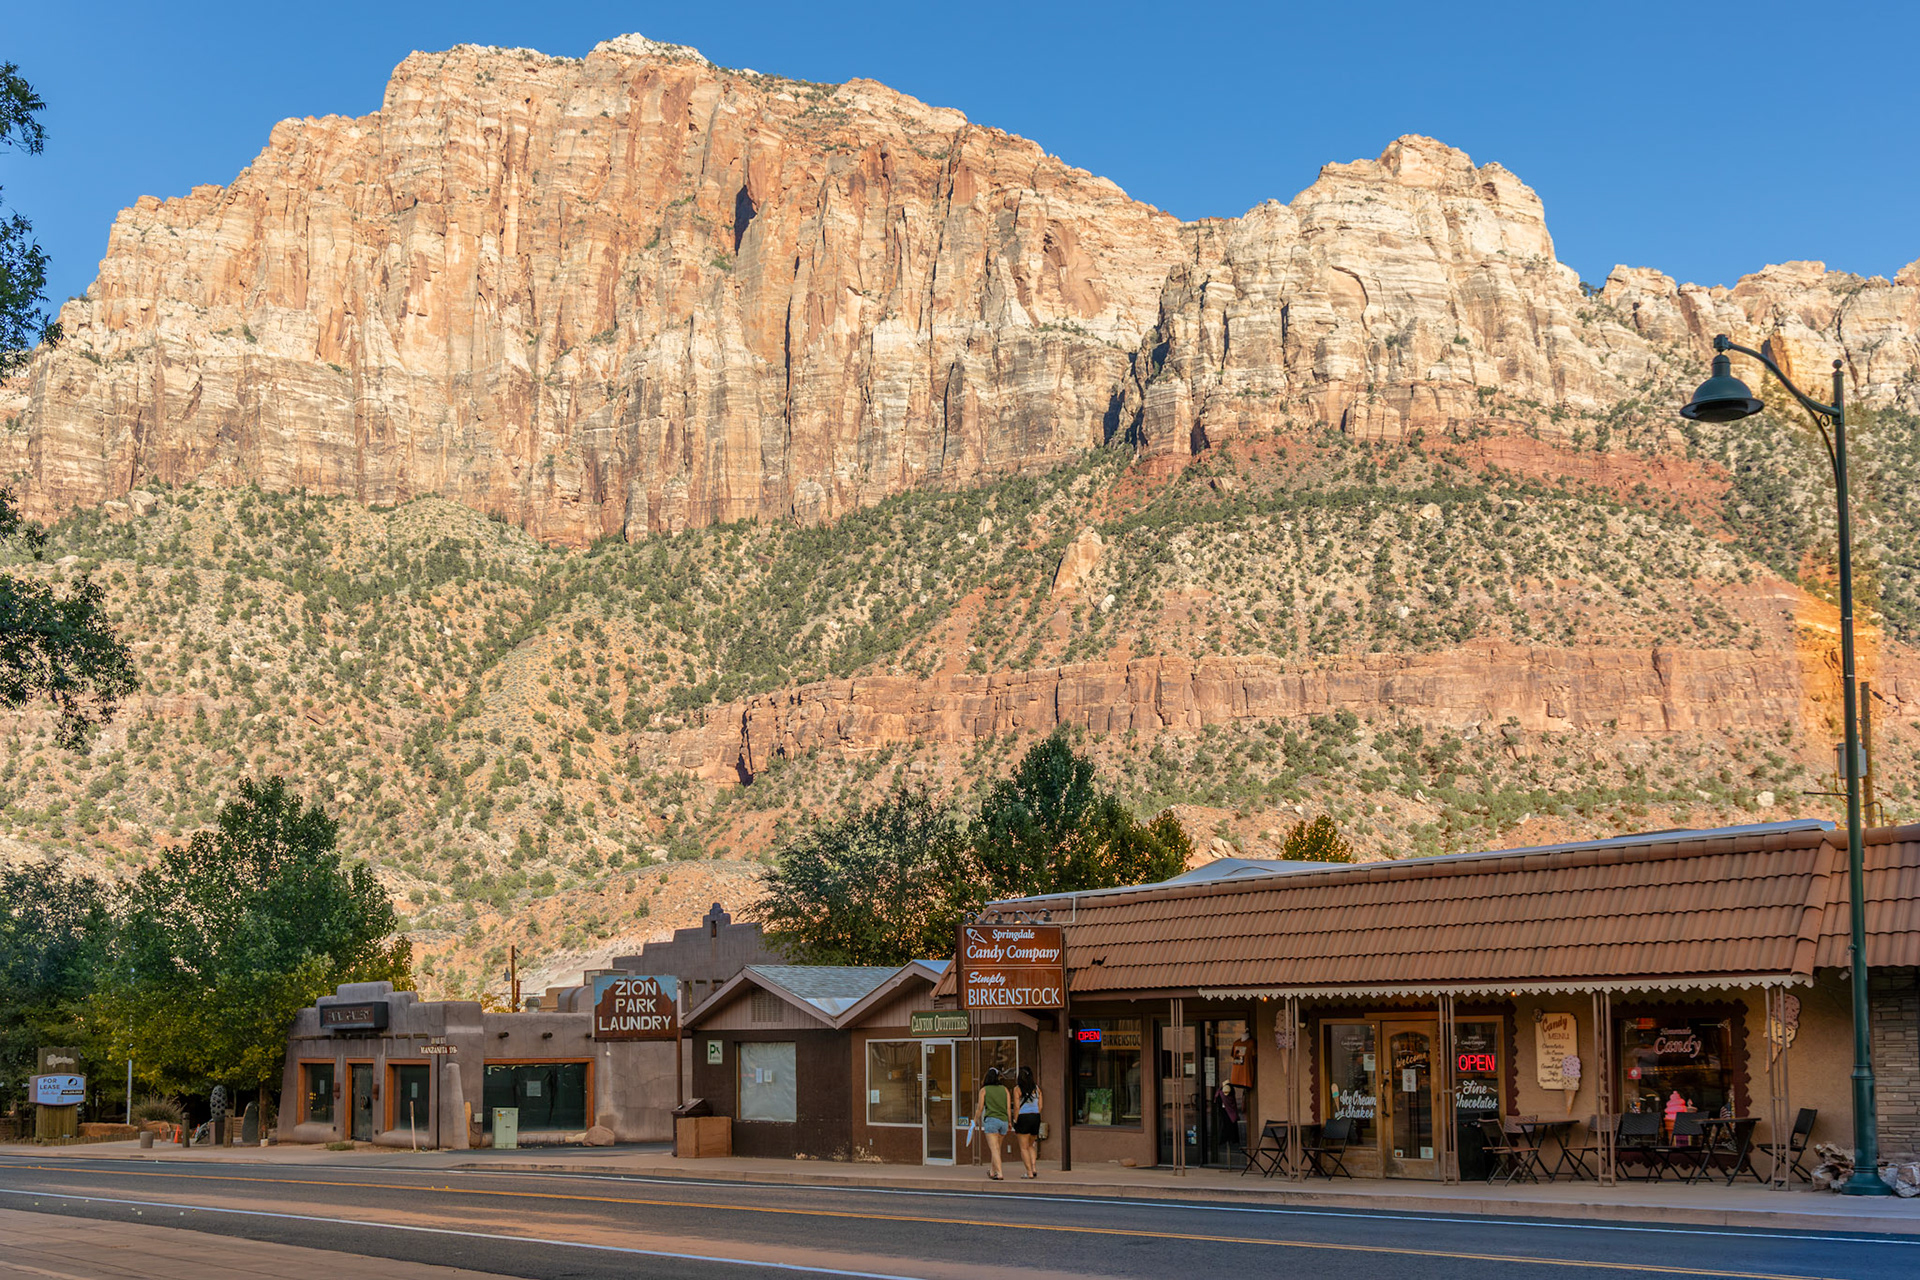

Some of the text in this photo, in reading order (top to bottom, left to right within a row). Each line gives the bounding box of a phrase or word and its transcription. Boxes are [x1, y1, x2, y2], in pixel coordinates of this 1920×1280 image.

[992, 929, 1035, 942] Springdale
[966, 945, 1060, 962] Candy Company
[968, 971, 1006, 986] Simply
[615, 980, 657, 996] ZION
[968, 987, 1060, 1006] BIRKENSTOCK
[615, 998, 656, 1013] PARK
[599, 1015, 672, 1031] LAUNDRY
[912, 1016, 933, 1032] CANYON
[1542, 1016, 1568, 1033] Candy
[1078, 1031, 1100, 1041] OPEN
[1653, 1034, 1702, 1058] Candy
[1458, 1054, 1495, 1071] OPEN
[1462, 1080, 1488, 1095] Fine
